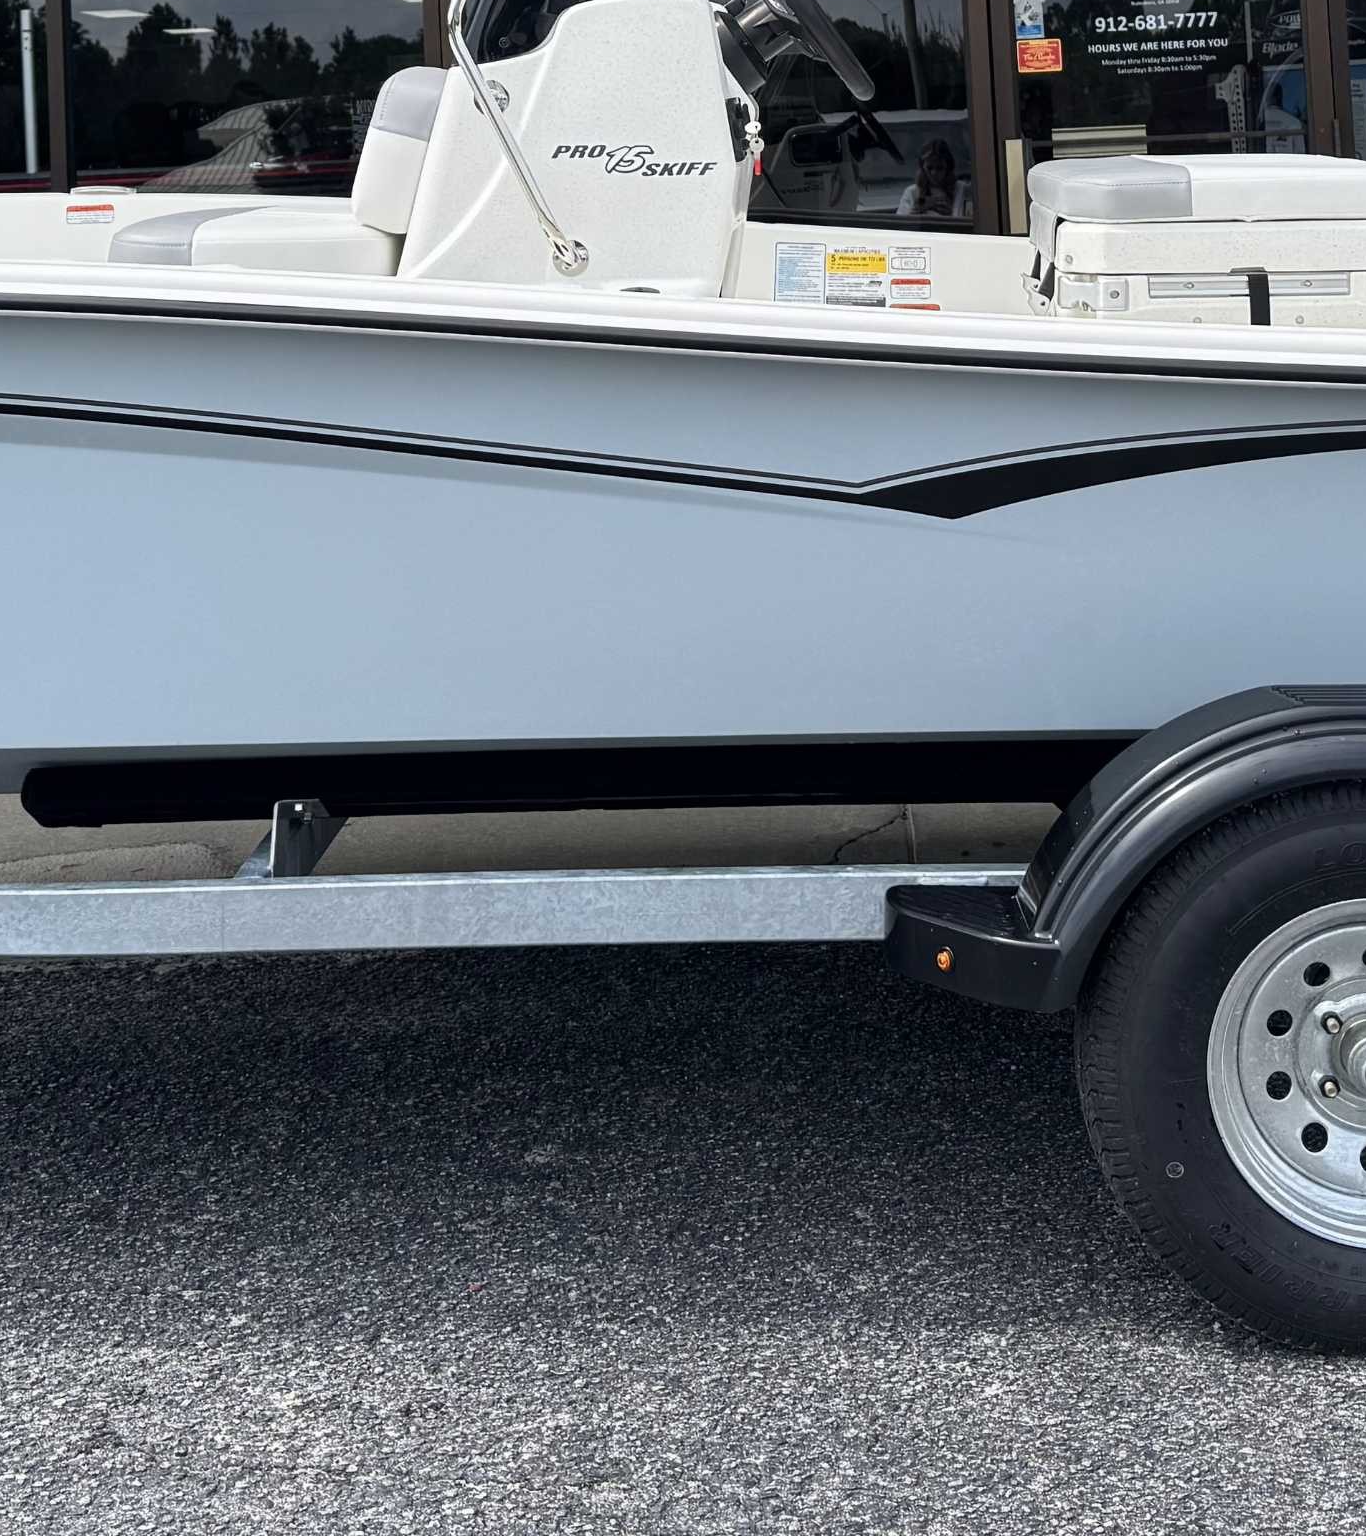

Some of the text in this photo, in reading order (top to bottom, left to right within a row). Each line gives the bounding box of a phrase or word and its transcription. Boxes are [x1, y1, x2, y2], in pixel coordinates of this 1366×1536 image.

[1094, 11, 1218, 32] 912-681-7777
[1088, 38, 1228, 53] HOURS WE ARE HERE FOR YOU
[1101, 57, 1126, 66] Monday
[1141, 56, 1160, 64] Friday
[551, 144, 718, 177] PRO 15 SKIFF
